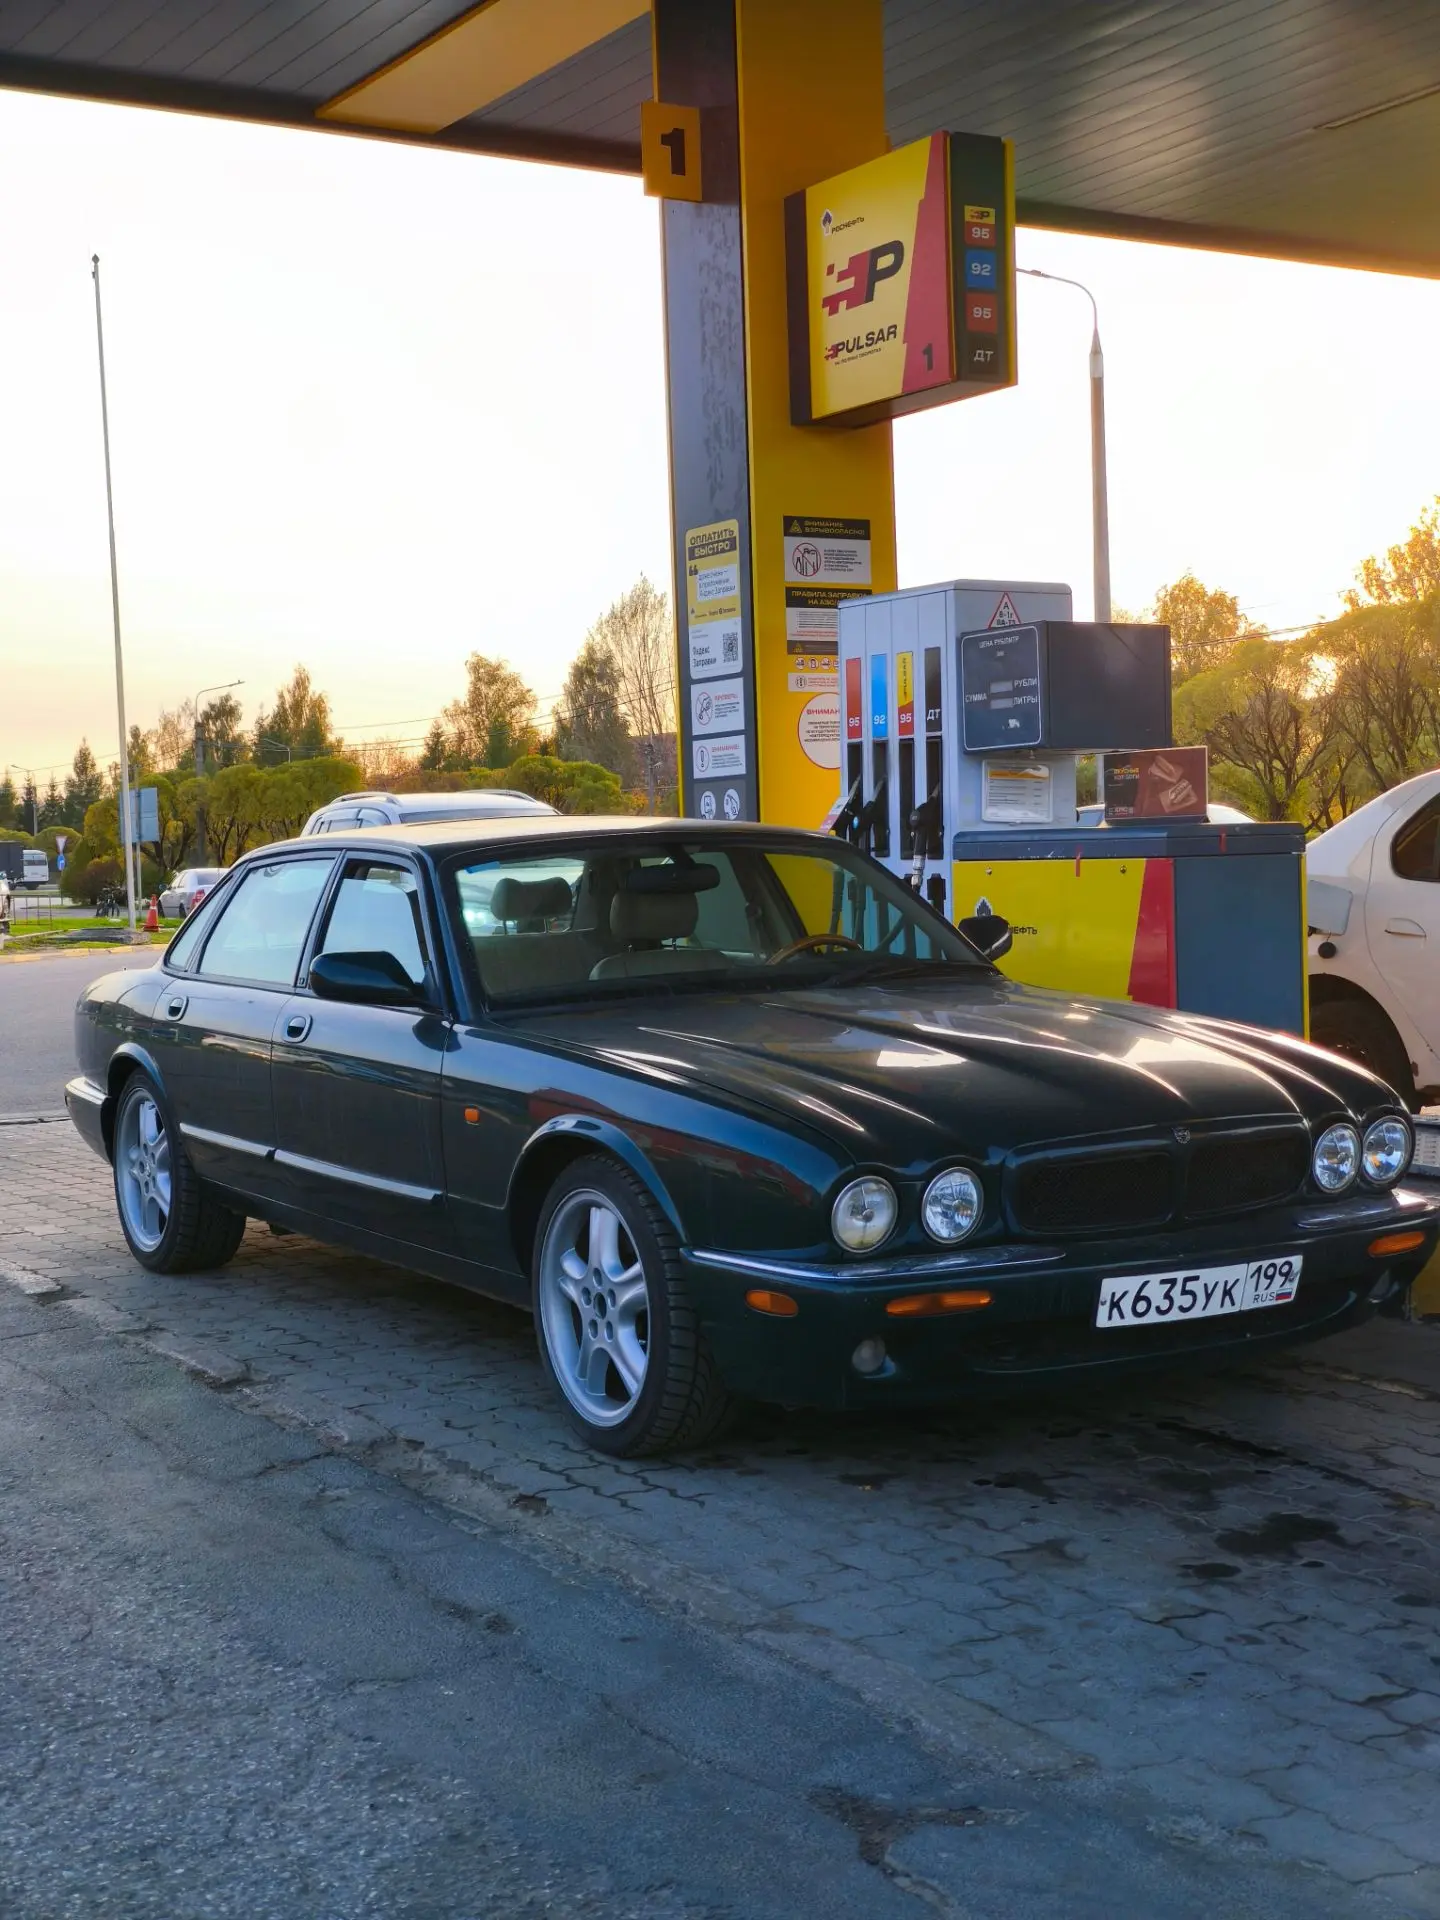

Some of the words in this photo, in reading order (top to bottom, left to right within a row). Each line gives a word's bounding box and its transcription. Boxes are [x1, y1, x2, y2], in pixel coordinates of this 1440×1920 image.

[661, 127, 686, 176] 1
[831, 216, 865, 234] РОСНЕФТЬ
[971, 226, 990, 239] 95
[971, 262, 991, 276] 92
[972, 306, 992, 319] 95
[836, 324, 898, 358] PULSAR
[922, 342, 934, 372] 1
[973, 349, 994, 363] ДТ
[689, 527, 735, 546] ОПЛАТИТЬ
[694, 540, 730, 557] БЫСТРО
[791, 590, 826, 598] ПРАВИЛА
[1014, 677, 1037, 688] РУБЛИ
[965, 692, 988, 703] СУММА
[1013, 695, 1038, 706] ЛИТРЫ
[873, 714, 886, 725] 92
[900, 712, 912, 724] 95
[926, 708, 941, 721] ДТ
[848, 716, 860, 727] 95
[1008, 926, 1038, 935] НЕФТЬ
[1250, 1260, 1293, 1293] 199
[1253, 1291, 1276, 1304] RUS
